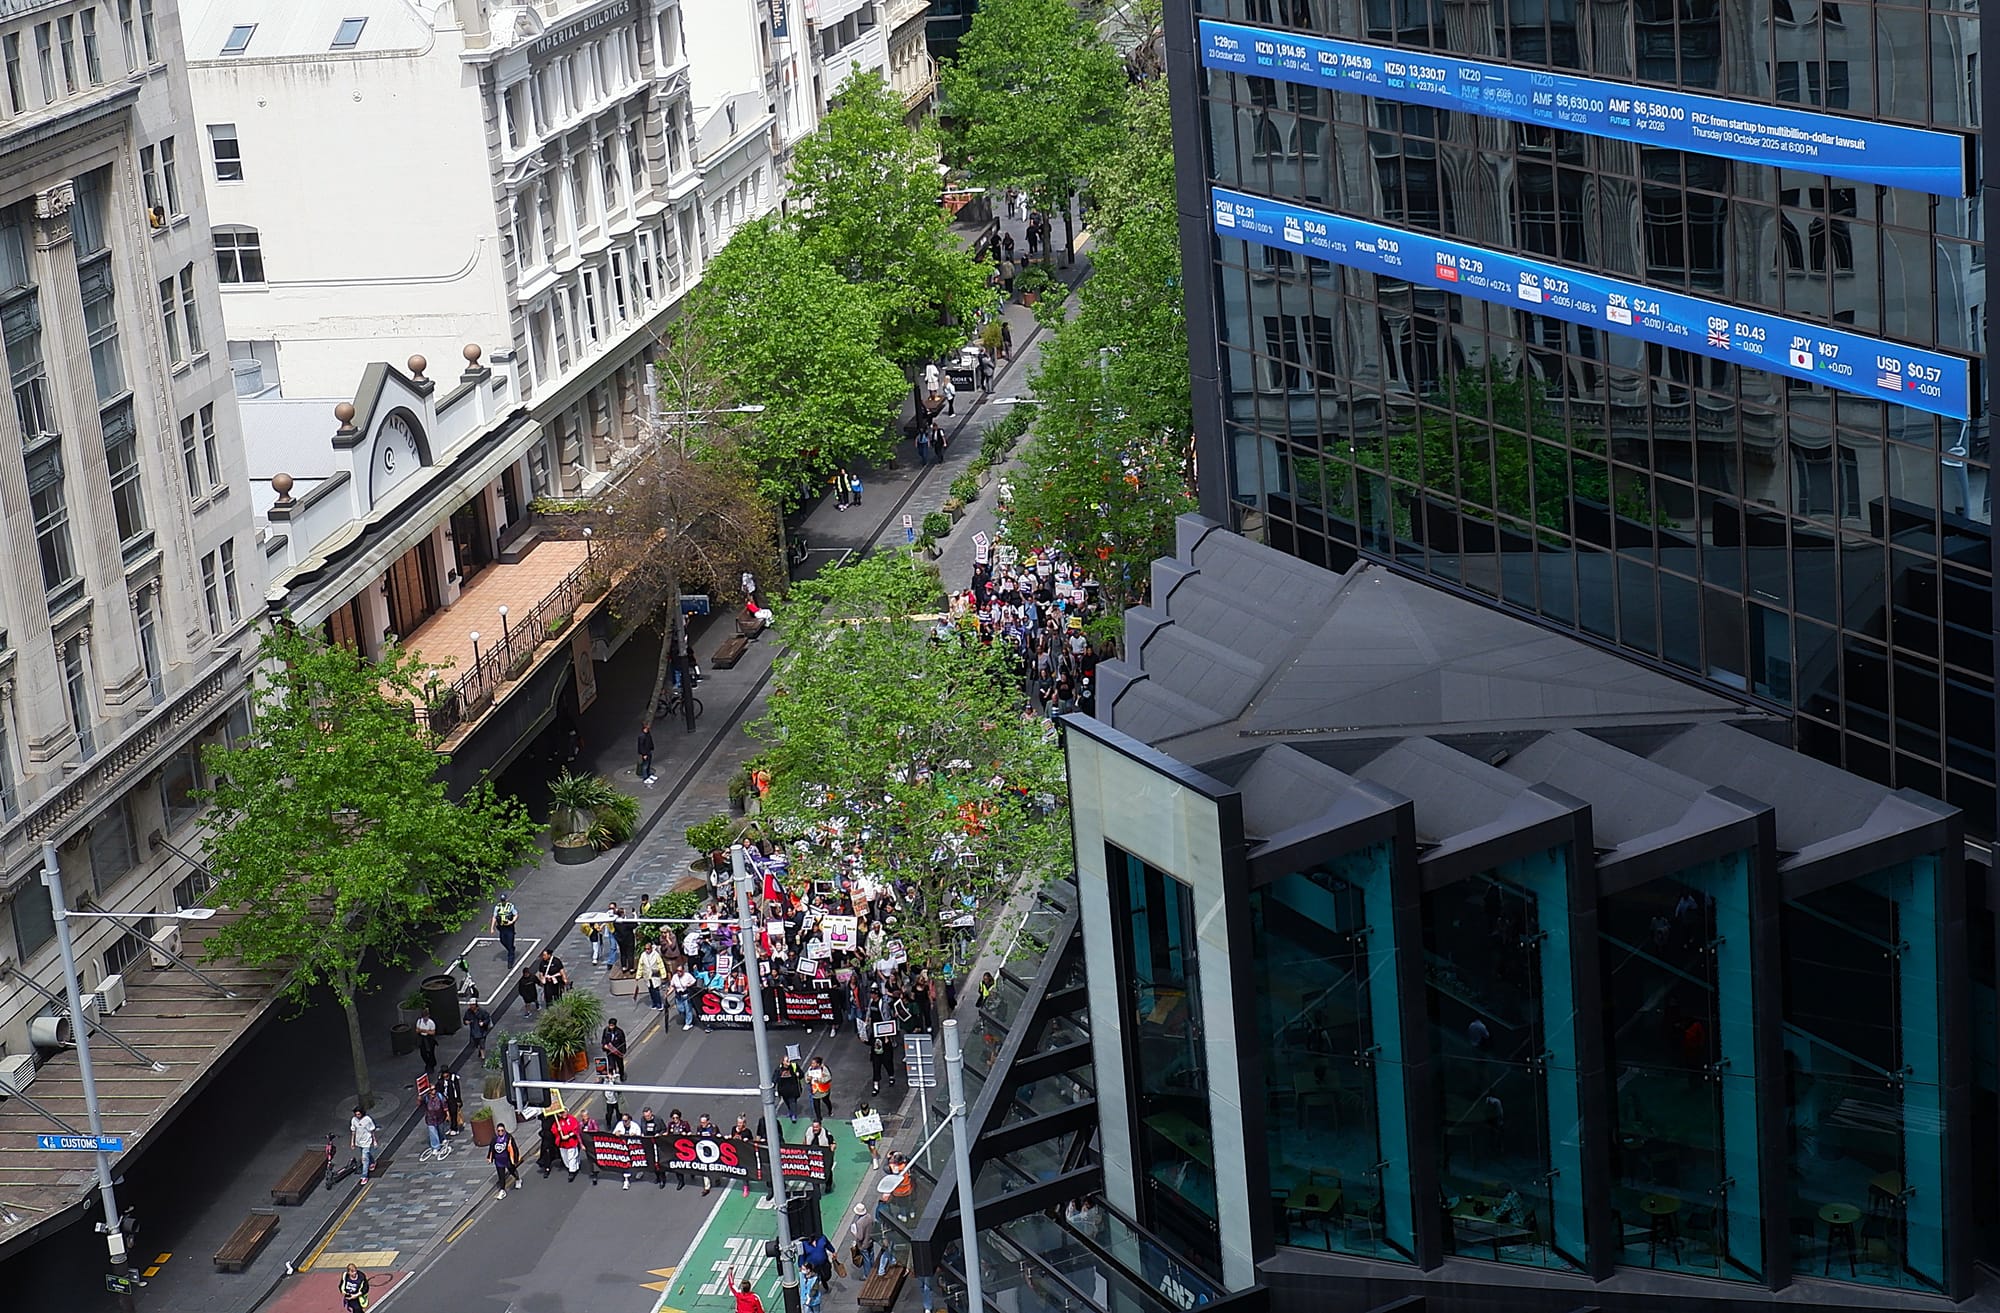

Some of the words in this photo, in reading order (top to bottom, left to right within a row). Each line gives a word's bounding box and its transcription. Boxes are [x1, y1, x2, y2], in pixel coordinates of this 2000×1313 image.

[536, 24, 580, 54] IMPERIAL
[583, 1, 629, 32] BUILDINGS
[1216, 50, 1233, 60] October
[1256, 41, 1274, 54] NZ10
[1276, 44, 1306, 58] 1,914.95
[1258, 56, 1273, 66] INDEX
[1318, 51, 1338, 65] NZ20
[1340, 54, 1372, 69] 7,645.19
[1321, 66, 1337, 77] INDEX
[1385, 62, 1406, 76] NZ50
[1408, 64, 1446, 82] 13,330.17
[1459, 67, 1480, 82] NZ20
[1388, 78, 1405, 88] INDEX
[1531, 74, 1554, 87] NZ20
[1532, 92, 1552, 106] AMF
[1556, 94, 1603, 112] $6,630.00
[1608, 98, 1630, 114] AMF
[1634, 100, 1684, 120] $6,580.00
[1534, 108, 1552, 118] FUTURE
[1558, 110, 1570, 122] Mar
[1571, 112, 1587, 124] 2026
[1610, 116, 1630, 126] FUTURE
[1636, 118, 1648, 130] Apr
[1648, 119, 1665, 131] 2026
[1692, 112, 1709, 124] FNZ:
[1710, 115, 1728, 127] from
[1730, 119, 1756, 134] startup
[1758, 122, 1766, 134] to
[1767, 124, 1835, 146] multibillion-dollar
[1836, 135, 1866, 150] lawsuit
[1692, 126, 1722, 143] Thursday
[1724, 131, 1733, 142] 09
[1734, 132, 1761, 147] October
[1762, 137, 1780, 150] 2025
[1780, 140, 1788, 150] at
[1788, 141, 1805, 153] 6:00
[1806, 144, 1818, 156] PM
[1216, 200, 1233, 214] PGW
[1236, 204, 1254, 218] $2.31
[1286, 216, 1300, 230] PHL
[1378, 238, 1398, 253] $0.10
[1384, 254, 1396, 264] 0.00
[1436, 252, 1456, 266] RYM
[1460, 256, 1483, 274] $2.79
[1520, 272, 1538, 286] SKC
[1544, 276, 1569, 294] $0.73
[1608, 293, 1628, 308] SPK
[1634, 298, 1660, 316] $2.41
[1642, 317, 1661, 329] -0.010
[1666, 322, 1682, 334] -0.41
[1708, 316, 1728, 332] GBP
[1736, 323, 1766, 341] £0.43
[1790, 336, 1812, 352] JPY
[1818, 342, 1838, 358] ¥87
[1828, 362, 1852, 376] +0.070
[1877, 356, 1901, 372] USD
[1908, 362, 1942, 382] $0.57
[1918, 384, 1941, 398] -0.001
[389, 416, 417, 460] ARCADE
[699, 1014, 716, 1022] AVE
[716, 1014, 734, 1022] OUR
[60, 1138, 98, 1149] CUSTOMS
[594, 1142, 628, 1151] MARANGA
[596, 1154, 630, 1162] MARANGA
[674, 1138, 738, 1167] SOS
[632, 1160, 648, 1168] AKE
[670, 1161, 691, 1170] SAVE
[692, 1163, 708, 1172] OUR
[709, 1163, 747, 1176] SERVICES
[810, 1160, 824, 1168] AKE
